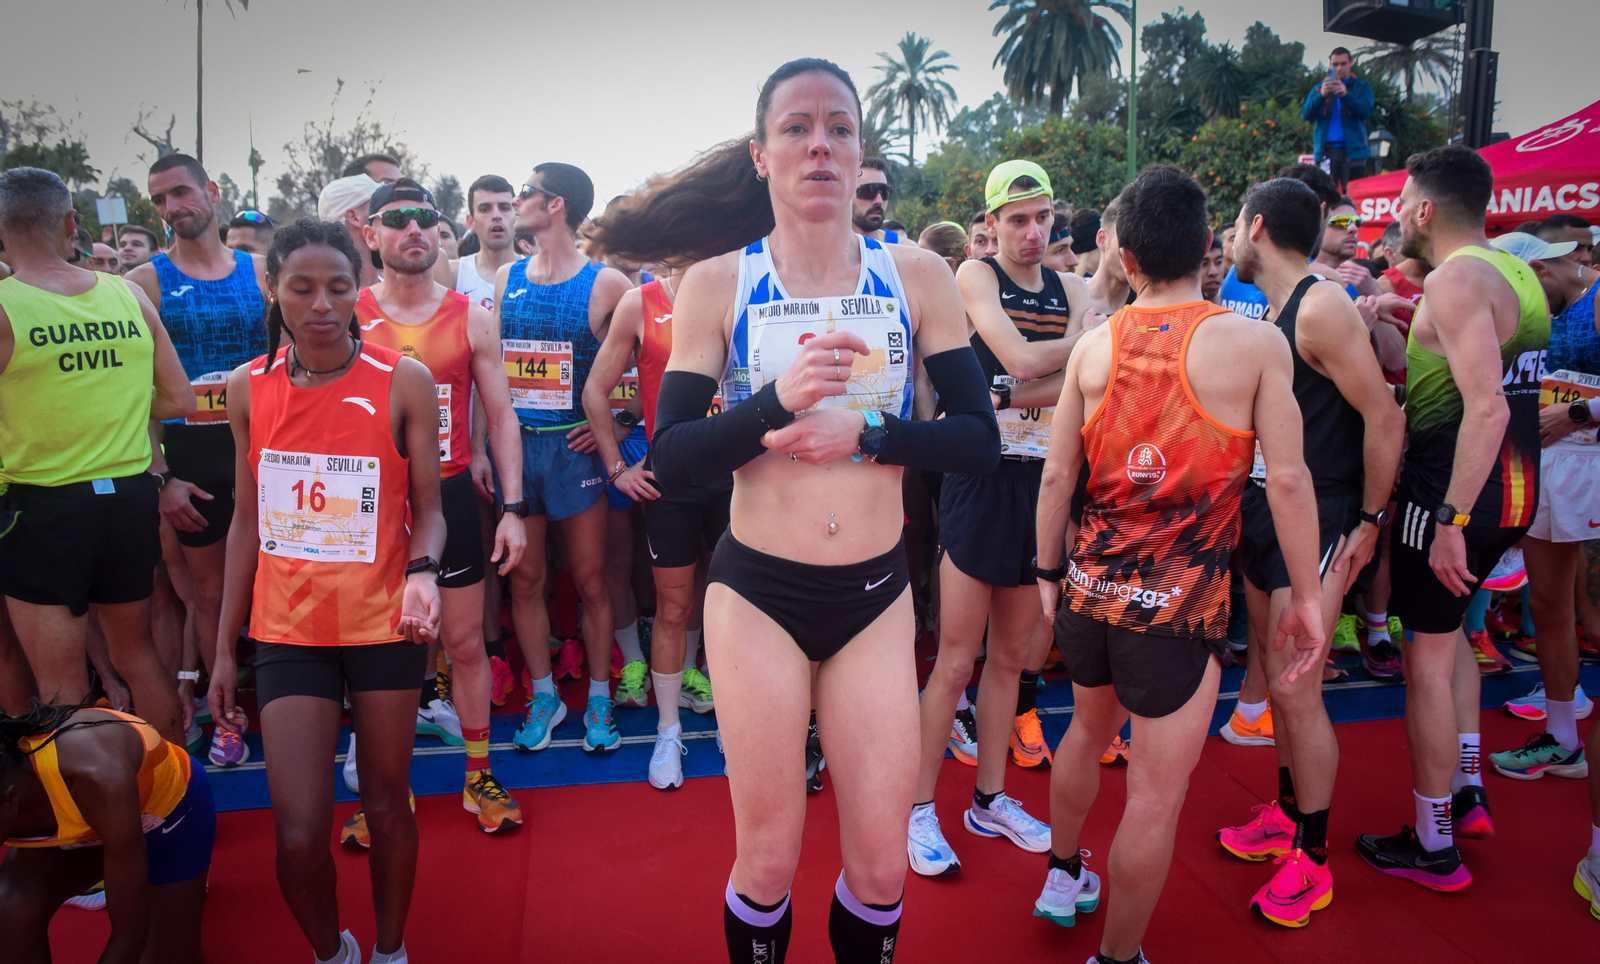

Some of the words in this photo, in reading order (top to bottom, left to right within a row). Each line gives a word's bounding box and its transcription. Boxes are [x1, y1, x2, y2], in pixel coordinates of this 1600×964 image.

[759, 306, 781, 319] MEDIO
[783, 302, 820, 316] MARATÓN
[841, 298, 884, 316] SEVILLA
[29, 320, 141, 347] GUARDIA
[540, 341, 563, 352] SEVILLA
[59, 349, 123, 372] CIVIL
[515, 356, 548, 378] 144
[263, 451, 280, 464] MEDIO
[281, 454, 311, 467] MARATÓN
[326, 456, 363, 473] SEVILLA
[291, 479, 326, 513] 16
[303, 546, 320, 555] HOKA
